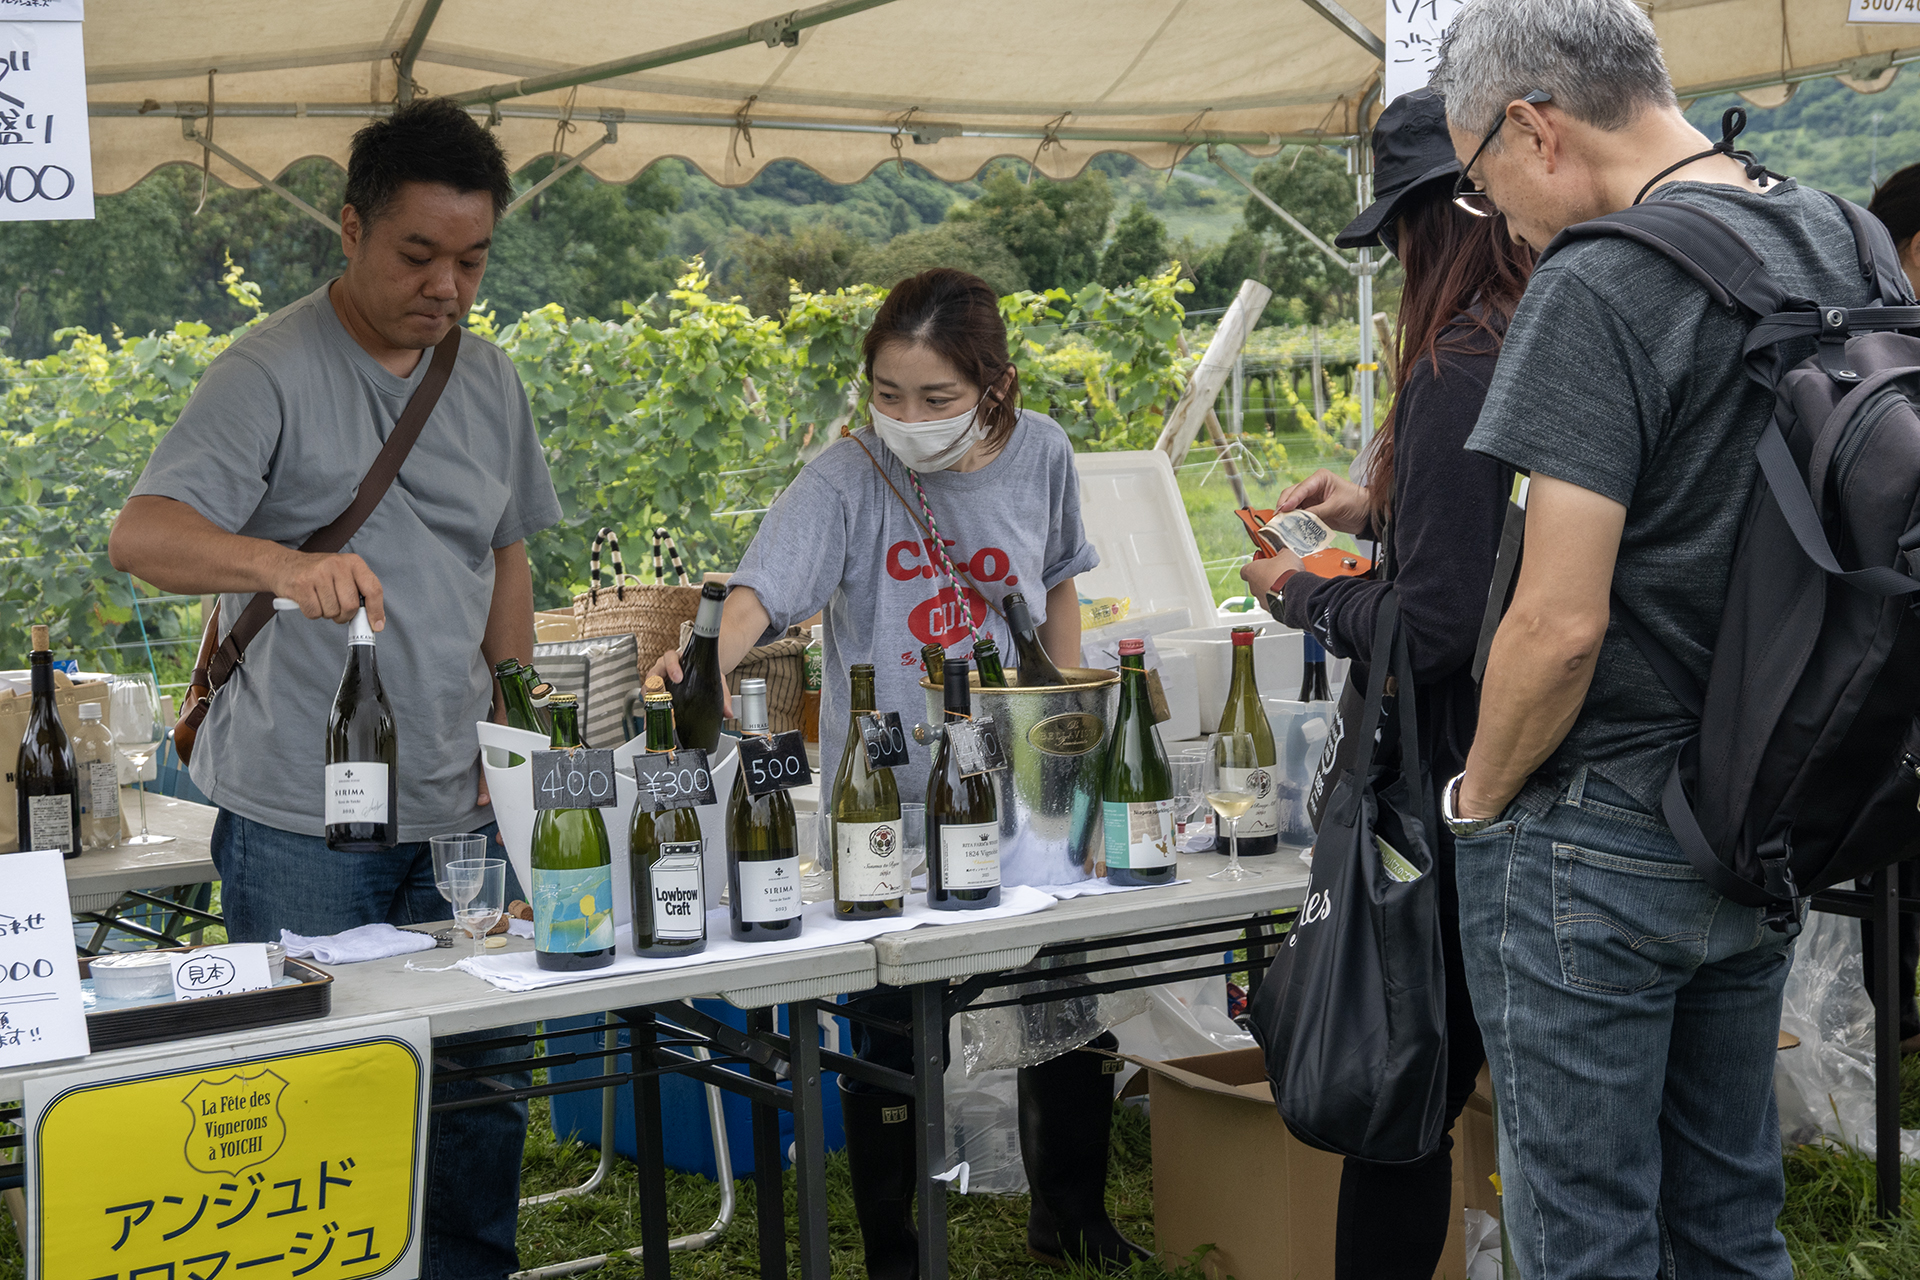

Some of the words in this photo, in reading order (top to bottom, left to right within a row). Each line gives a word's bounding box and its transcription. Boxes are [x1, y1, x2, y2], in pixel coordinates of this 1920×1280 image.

[0, 164, 75, 203] 00
[751, 755, 801, 786] 500
[335, 789, 365, 797] SIRIMA
[541, 769, 609, 799] 400
[642, 767, 711, 803] ¥300
[655, 887, 698, 902] Lowbrow
[764, 885, 794, 895] SIRIMA
[665, 902, 691, 916] Craft
[188, 963, 225, 987] 見本
[201, 1099, 217, 1117] La
[220, 1095, 247, 1114] Fête
[249, 1090, 271, 1108] des
[205, 1115, 268, 1139] Vignerons
[208, 1145, 217, 1161] à
[220, 1135, 263, 1160] YOICHI
[104, 1156, 357, 1252] アンジュド
[86, 1220, 381, 1280] マージュ
